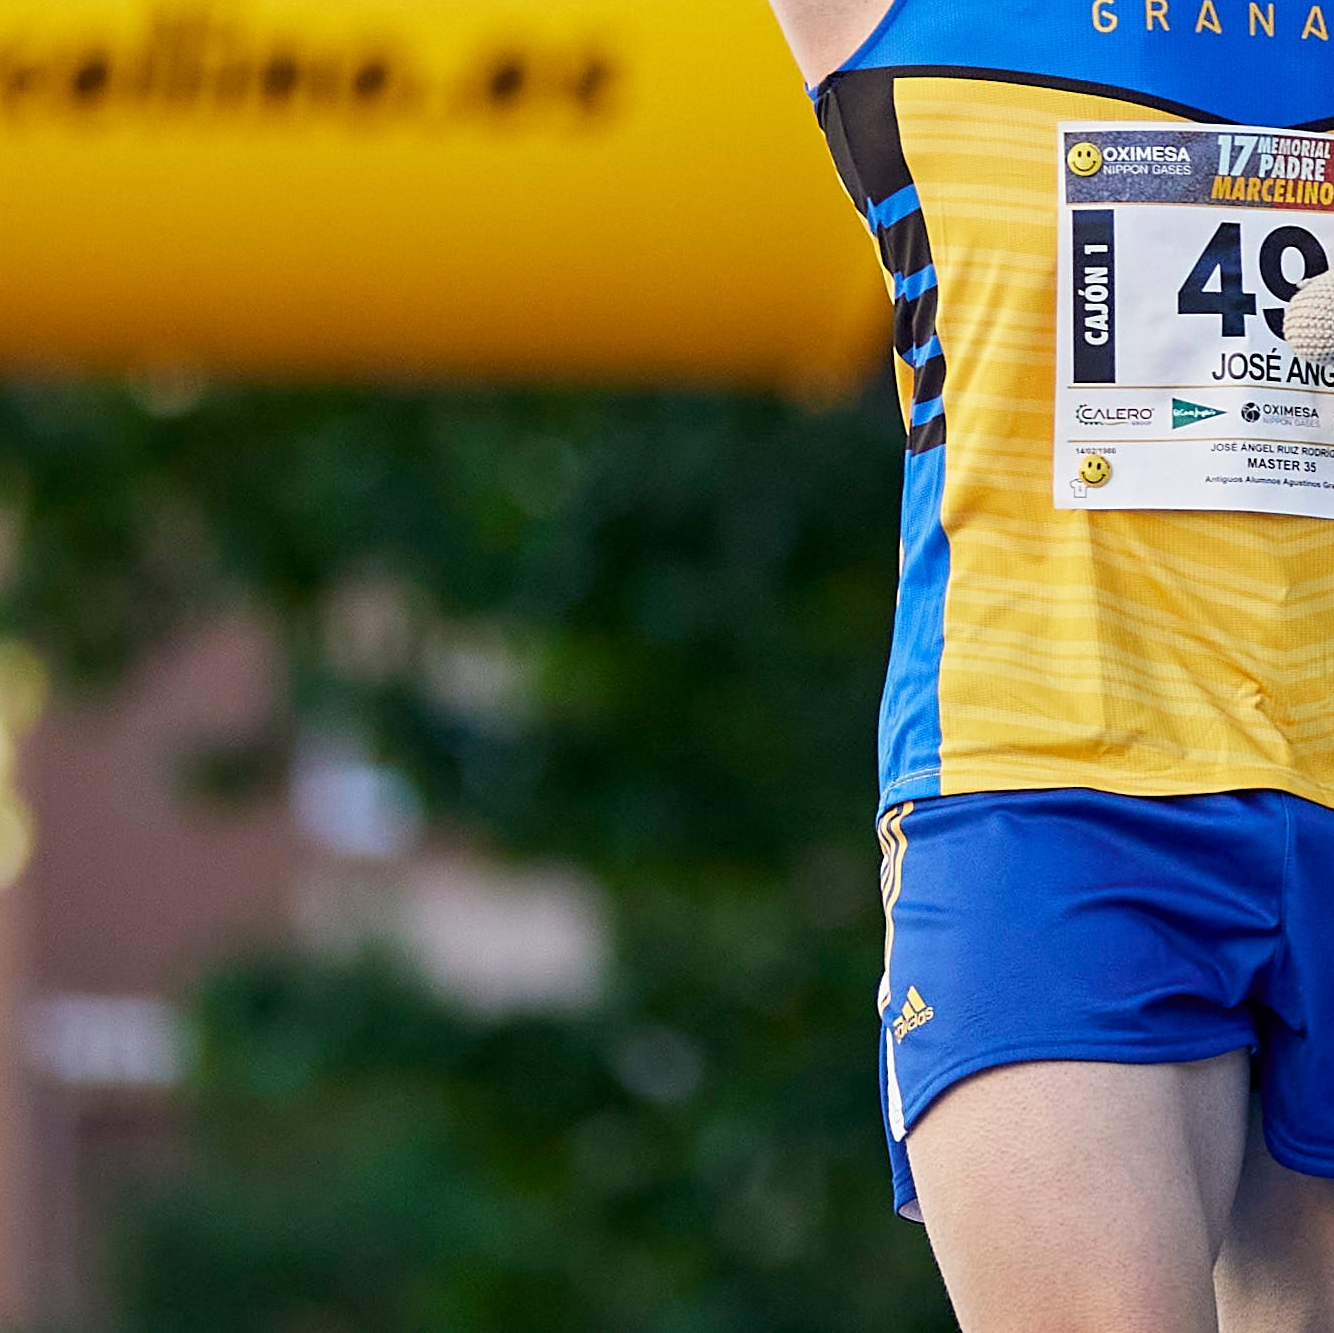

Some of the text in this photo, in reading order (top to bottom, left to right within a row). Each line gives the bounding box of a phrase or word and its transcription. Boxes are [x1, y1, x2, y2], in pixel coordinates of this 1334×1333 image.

[1103, 146, 1191, 162] OXIMESA
[1217, 135, 1331, 176] 17 MEMORIAL
[1103, 164, 1192, 175] NIPPON GASES
[1258, 154, 1326, 182] PADRE
[1210, 175, 1334, 206] MARCELINO
[1078, 244, 1109, 346] CAJÓN 1
[1211, 347, 1282, 382] JOSÉ
[1081, 408, 1153, 420] CALERO
[1262, 404, 1320, 418] OXIMESA
[1210, 442, 1238, 452] JOSÉ
[1277, 444, 1299, 455] RUIZ
[1247, 458, 1317, 472] MASTER 35
[1205, 475, 1243, 485] Antiguos
[1246, 476, 1281, 485] Alumnos
[1283, 478, 1321, 488] Agustinos
